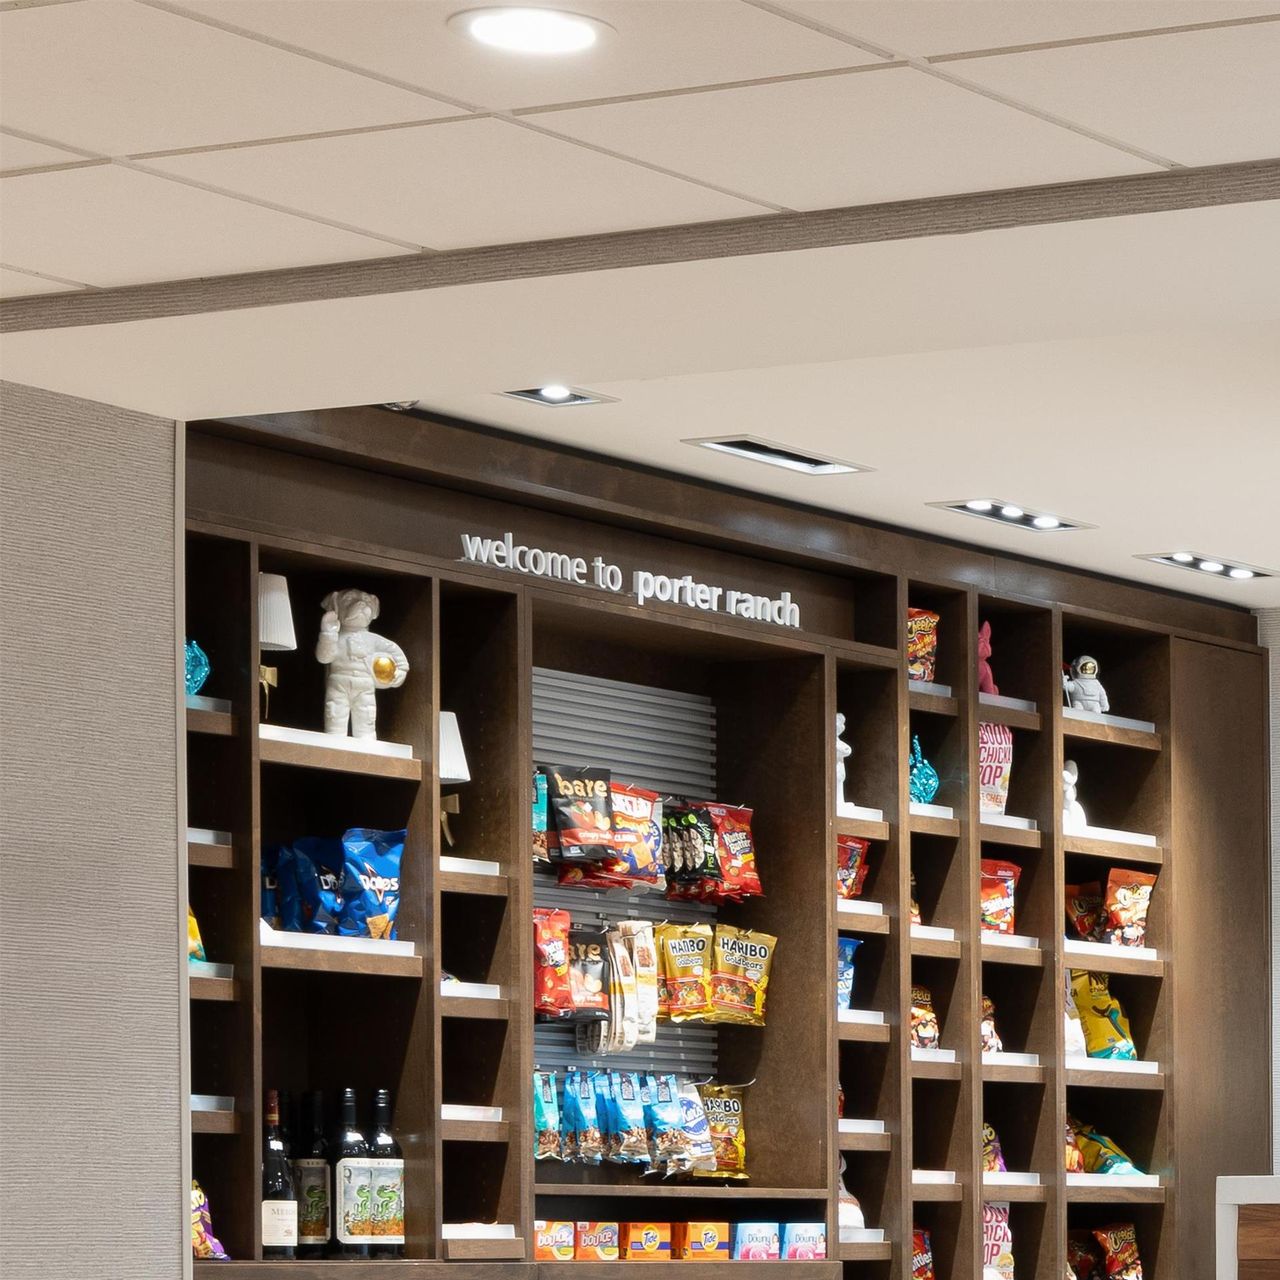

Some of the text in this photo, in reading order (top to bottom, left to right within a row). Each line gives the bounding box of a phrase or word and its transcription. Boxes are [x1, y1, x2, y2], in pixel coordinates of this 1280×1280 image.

[460, 532, 801, 628] welcome to porter ranch
[554, 773, 608, 798] bare
[567, 943, 602, 960] are
[581, 1230, 613, 1247] bounce
[643, 1231, 658, 1246] Tide
[703, 1231, 718, 1246] Tide
[747, 1233, 771, 1244] Downy
[982, 1243, 1001, 1265] OP
